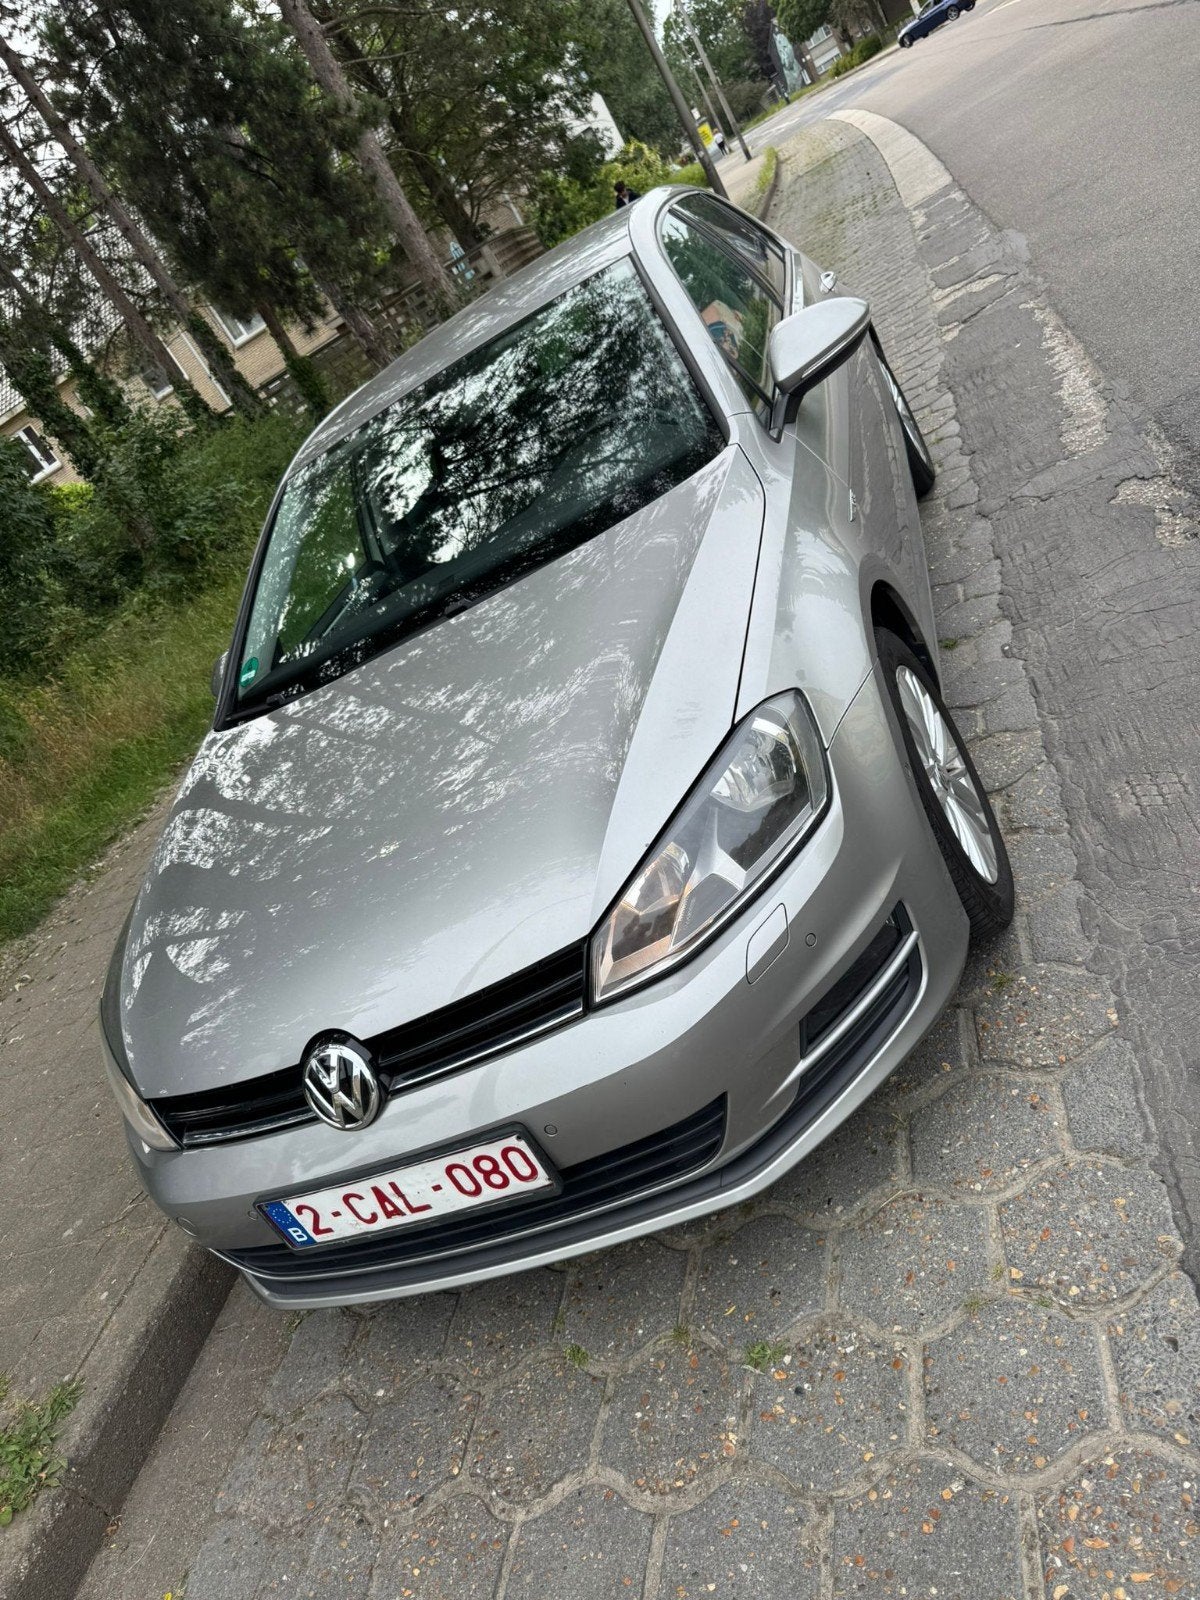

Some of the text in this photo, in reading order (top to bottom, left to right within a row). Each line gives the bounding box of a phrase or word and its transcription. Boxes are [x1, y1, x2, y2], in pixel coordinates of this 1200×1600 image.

[304, 1044, 378, 1129] VW
[295, 1146, 539, 1236] 2-CAL-080
[288, 1227, 308, 1242] B
